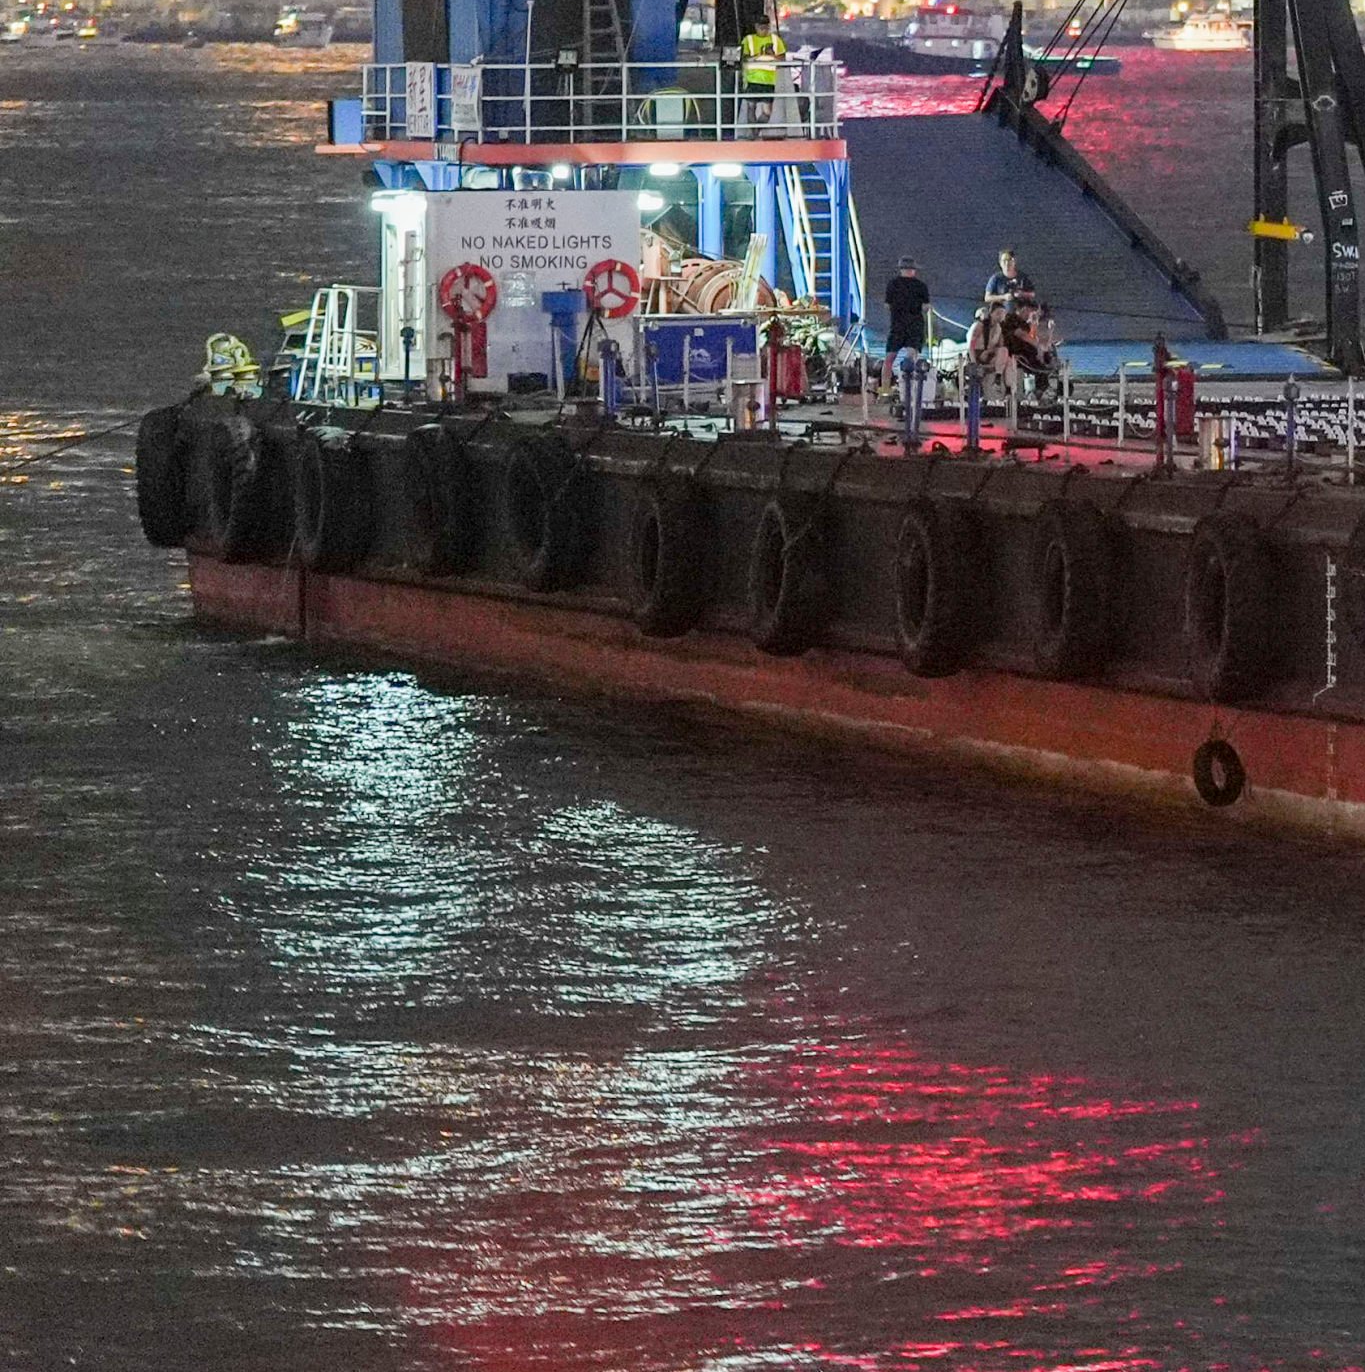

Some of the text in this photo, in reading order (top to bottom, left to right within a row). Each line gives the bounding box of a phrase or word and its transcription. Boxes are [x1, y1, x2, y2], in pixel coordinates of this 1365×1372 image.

[505, 198, 556, 211] 不准明火
[461, 235, 612, 249] NO NAKED LIGHTS
[480, 255, 588, 269] NO SMOKING
